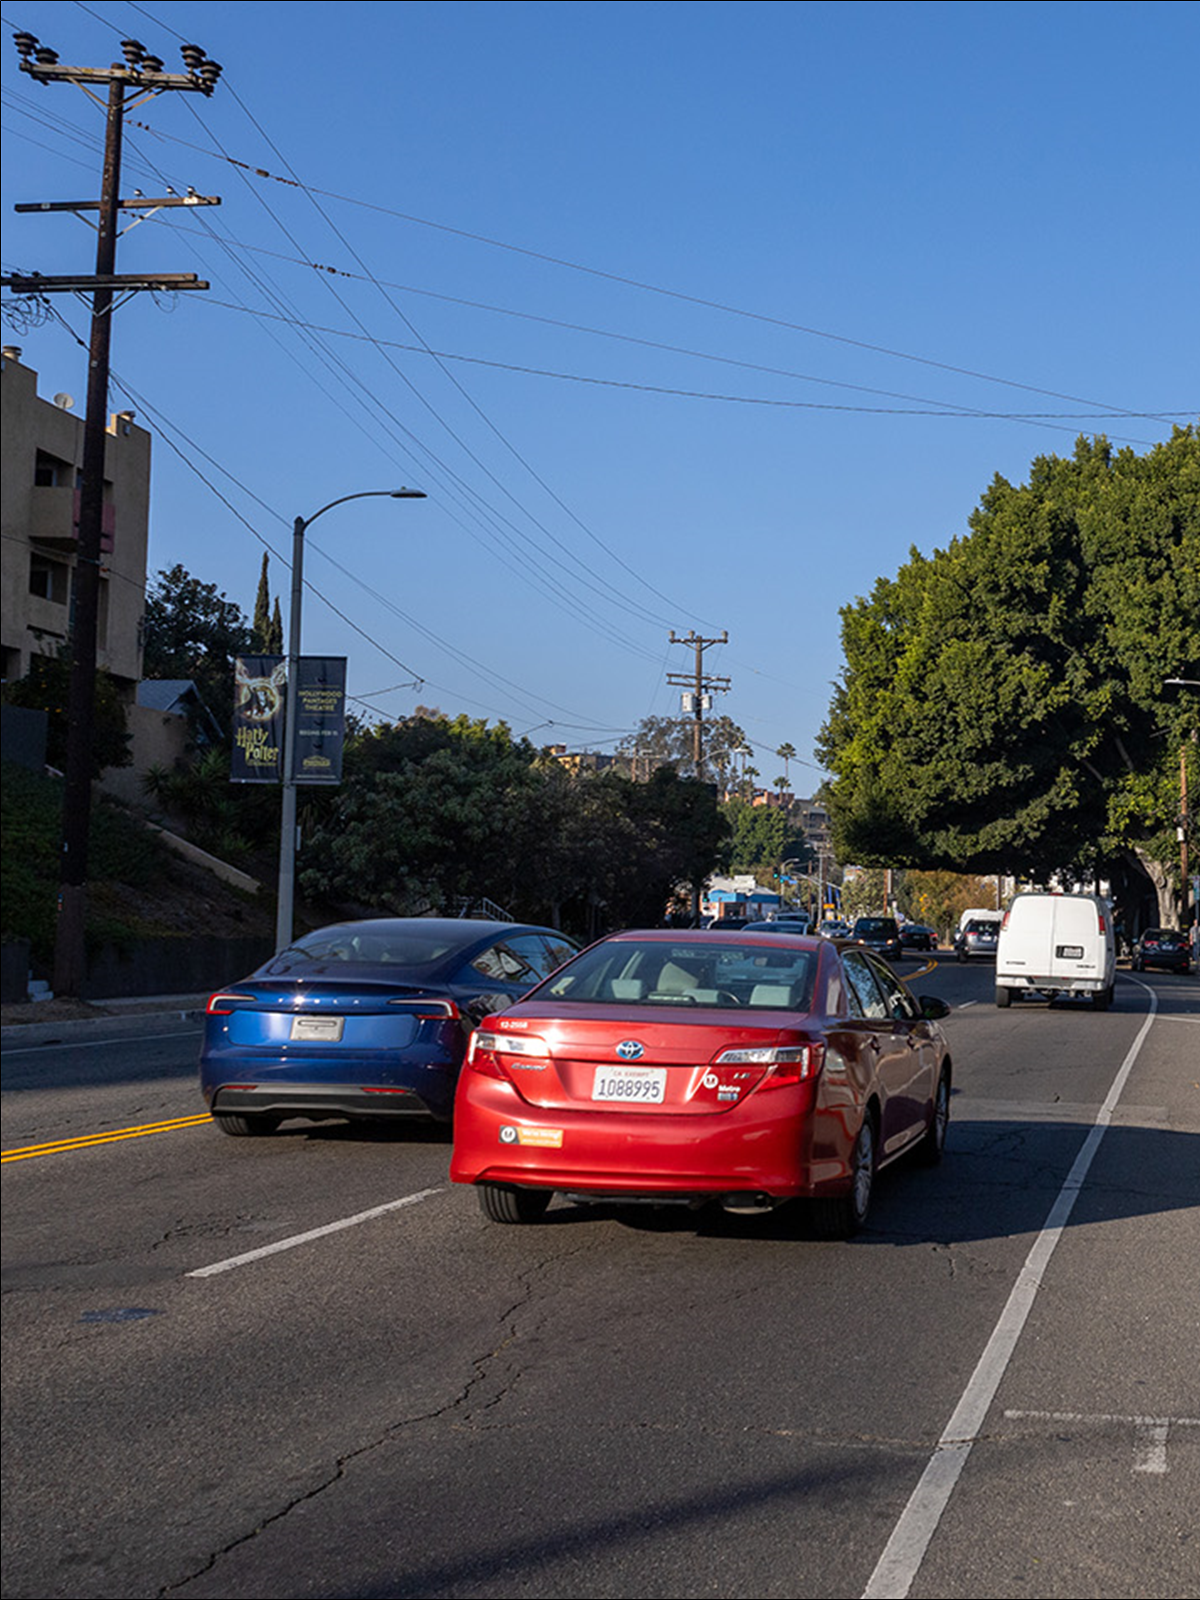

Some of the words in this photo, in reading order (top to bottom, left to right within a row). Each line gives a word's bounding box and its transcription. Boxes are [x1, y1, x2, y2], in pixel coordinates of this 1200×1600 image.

[235, 726, 269, 748] Harry
[245, 742, 280, 761] Potter
[598, 1079, 661, 1098] 1088995
